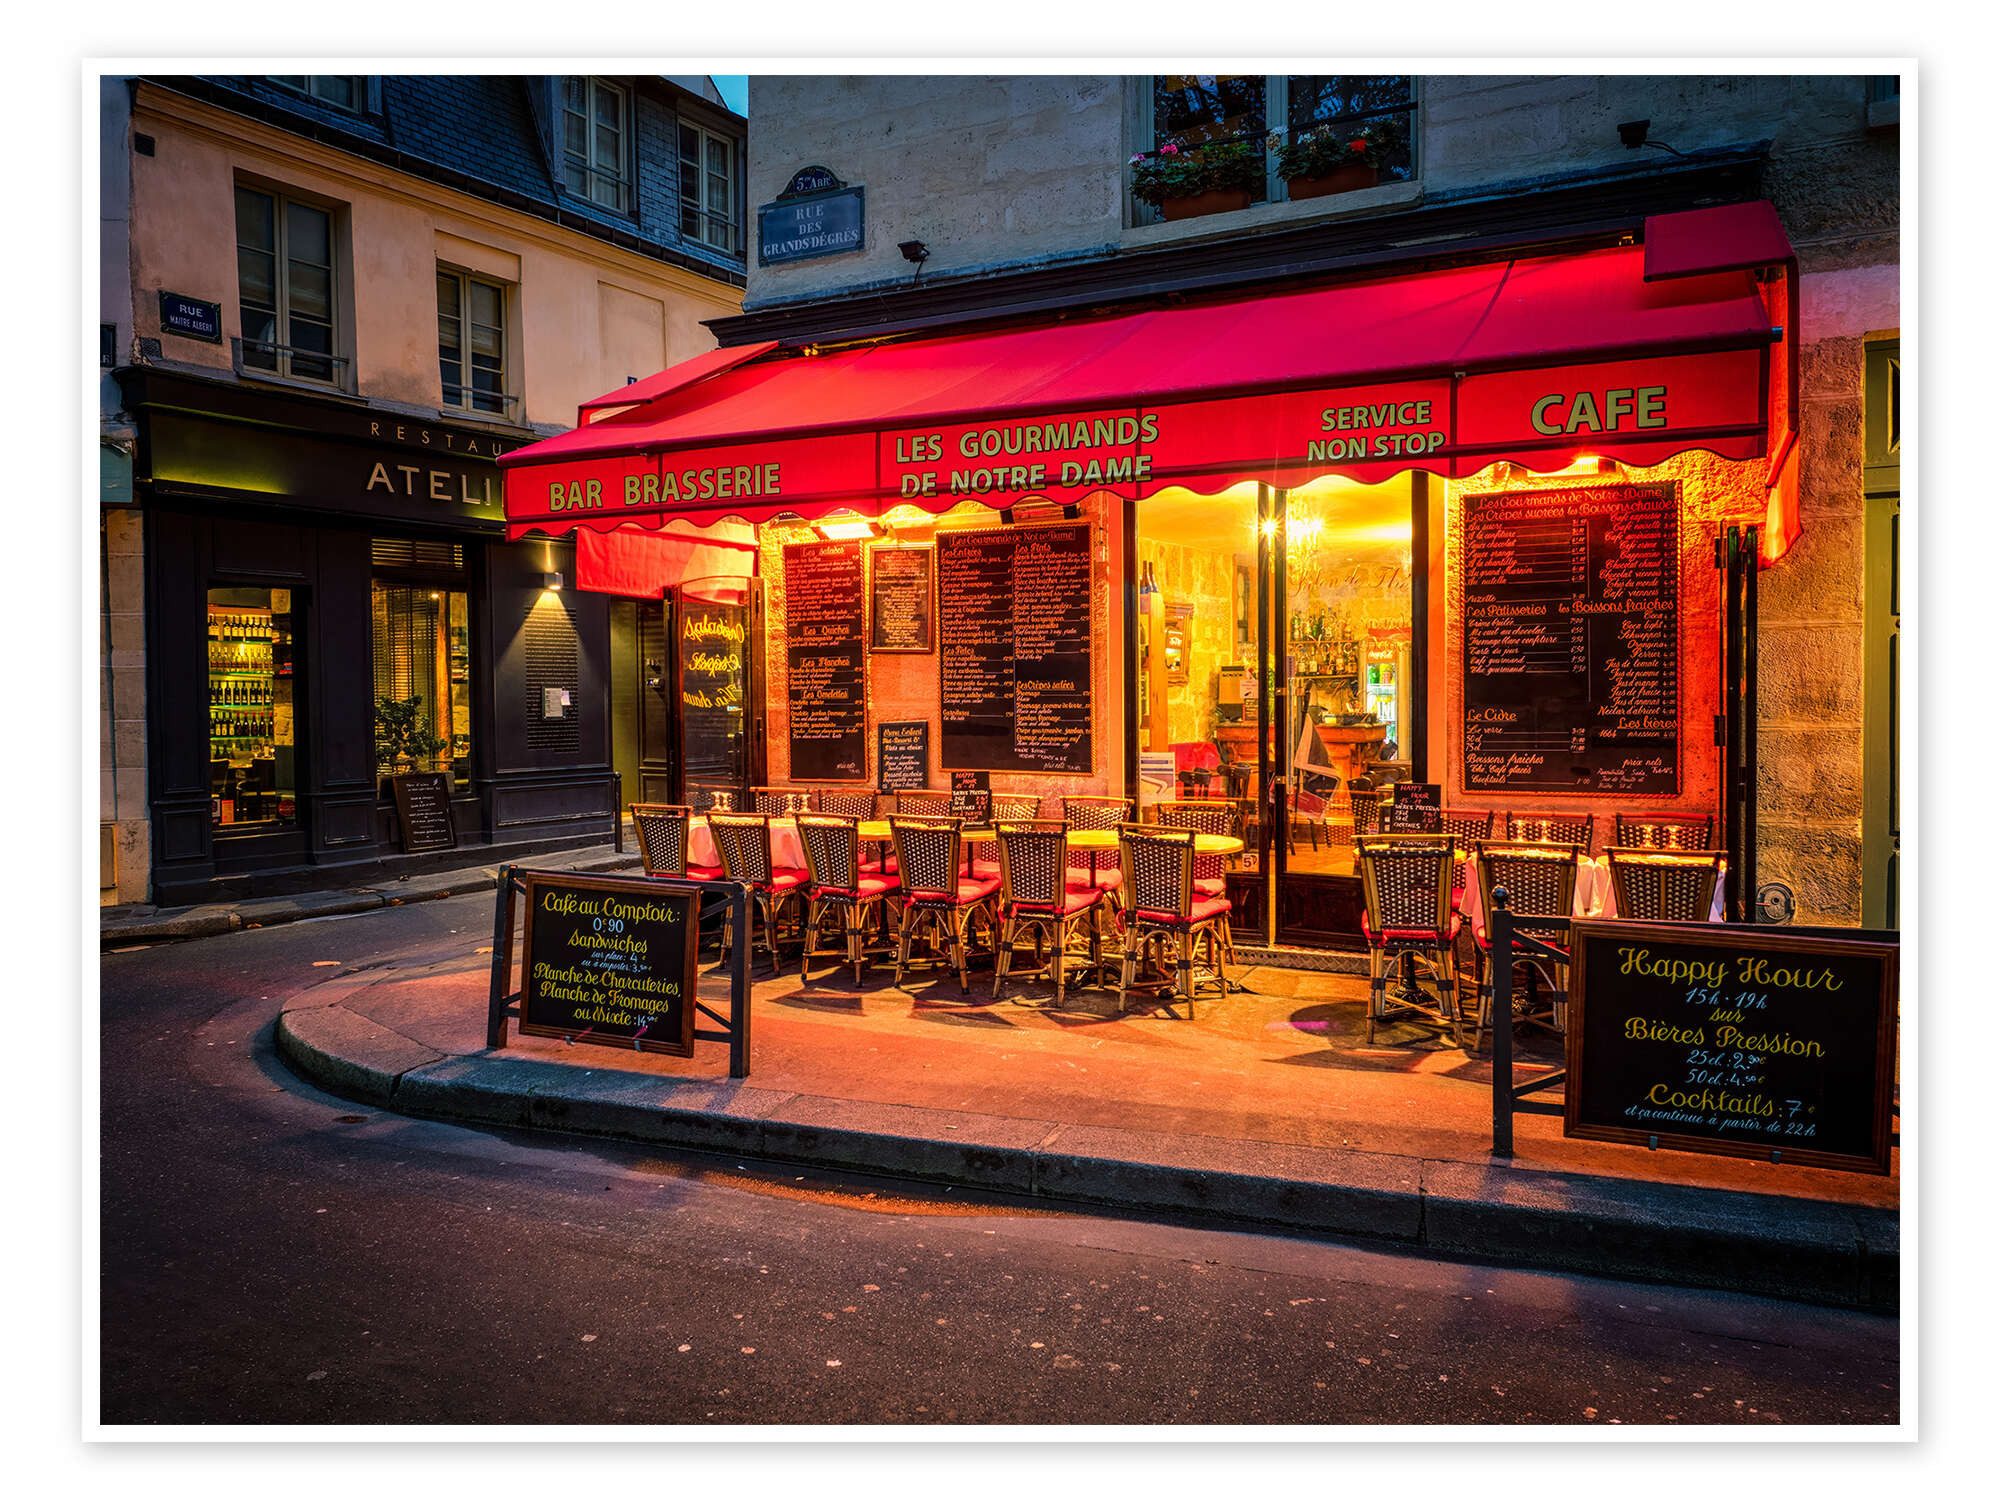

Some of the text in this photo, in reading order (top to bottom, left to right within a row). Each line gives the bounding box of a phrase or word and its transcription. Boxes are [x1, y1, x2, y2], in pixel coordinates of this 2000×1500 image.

[796, 205, 824, 220] RUE
[799, 220, 822, 235] DES
[763, 238, 809, 257] GRANDS
[179, 304, 203, 318] RUE
[1321, 401, 1432, 432] SERVICE
[1531, 386, 1668, 435] CAFE
[371, 422, 520, 456] RESTAU
[896, 414, 1159, 464] LES GOURMANDS
[1307, 431, 1446, 462] NON STOP
[366, 462, 504, 508] ATELI
[550, 463, 781, 511] BAR BRASSERIE
[901, 455, 1152, 499] DE NOTRE DAME
[1477, 497, 1499, 511] Les
[1500, 491, 1567, 509] Gourmands
[1569, 491, 1582, 502] de
[1579, 502, 1629, 516] Boissons
[1630, 499, 1677, 512] chaudes
[1466, 512, 1484, 522] Les
[1466, 606, 1485, 617] Les
[1572, 600, 1622, 613] Boissons
[1467, 708, 1517, 720] Le Cidre
[1617, 717, 1640, 729] Les
[543, 892, 577, 917] Café
[579, 901, 600, 916] au
[568, 928, 648, 954] Sandwiches
[533, 962, 583, 985] Planche
[585, 970, 599, 985] de
[1618, 947, 1843, 991] Happy Hour
[539, 981, 669, 1015] Planche de Fromages
[1686, 987, 1768, 1009] 15h 19h
[573, 1008, 591, 1020] ou
[1709, 1007, 1746, 1023] sur
[1625, 1017, 1826, 1057] Bières Pression
[1718, 1116, 1762, 1132] partir
[1766, 1120, 1781, 1133] de
[1785, 1121, 1816, 1137] 22h
